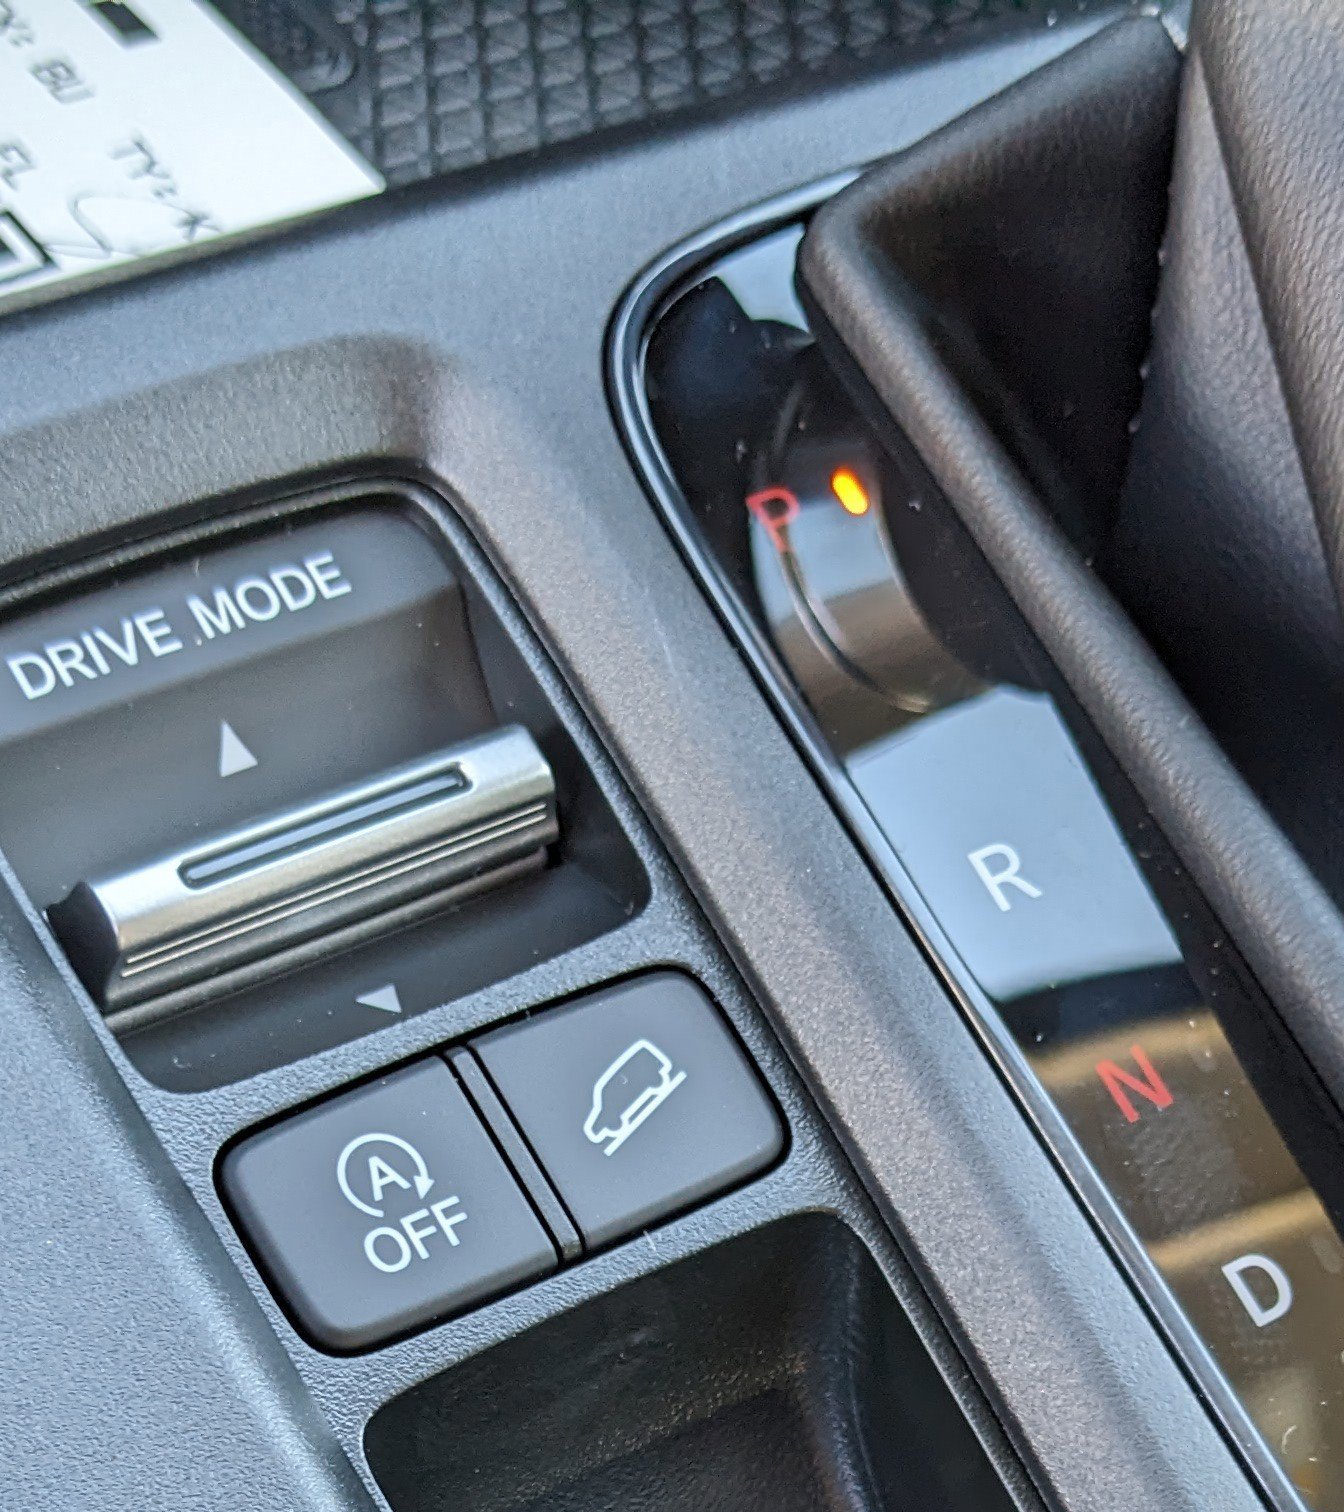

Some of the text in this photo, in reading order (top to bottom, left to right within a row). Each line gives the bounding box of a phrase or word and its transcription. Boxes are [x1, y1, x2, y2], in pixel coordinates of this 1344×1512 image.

[745, 488, 800, 554] P
[5, 550, 353, 700] DRIVE MODE
[967, 843, 1043, 912] R
[1095, 1044, 1175, 1123] N
[363, 1195, 468, 1274] OFF
[1221, 1253, 1293, 1328] D
